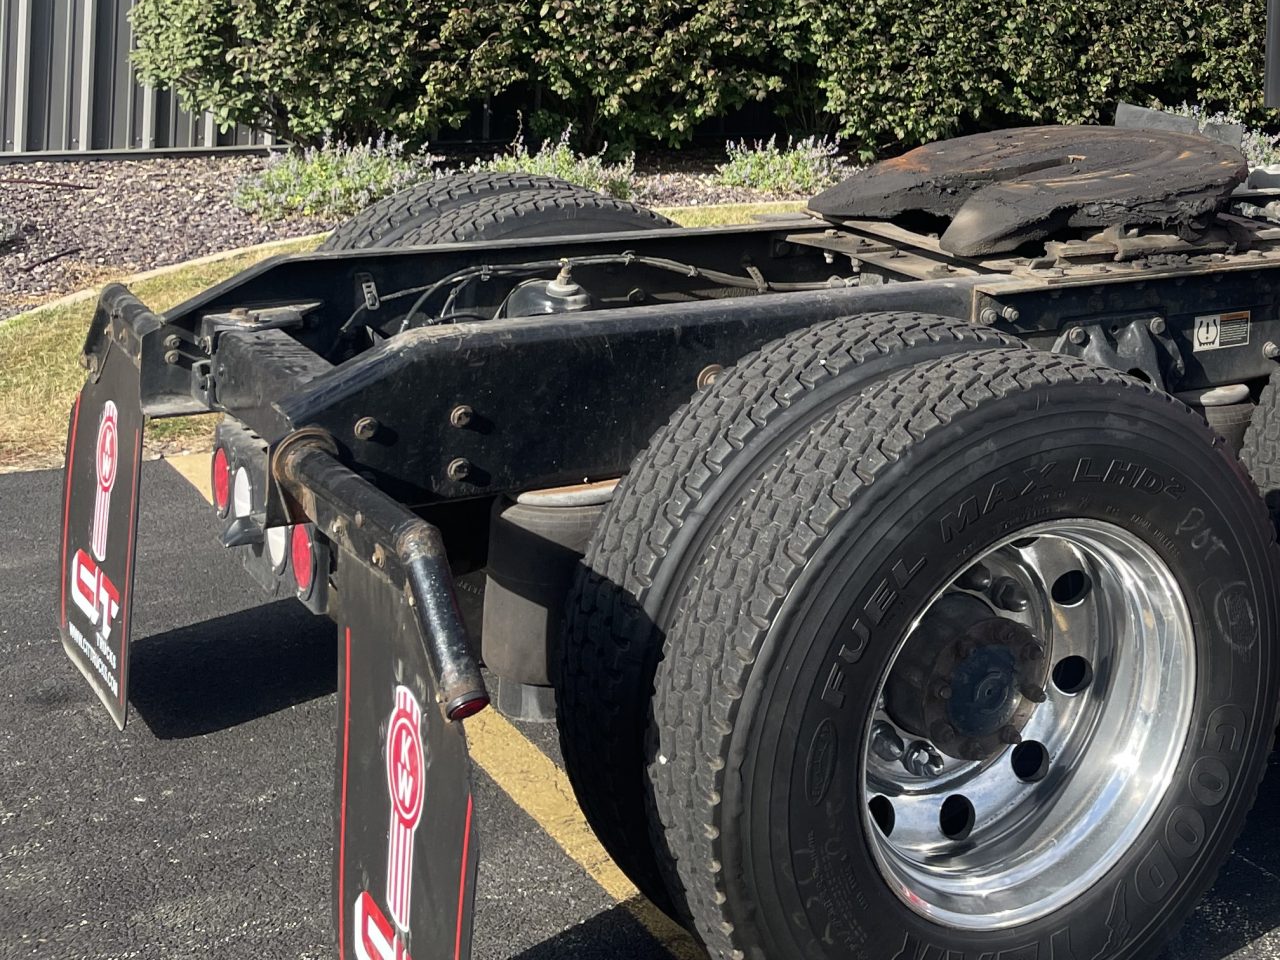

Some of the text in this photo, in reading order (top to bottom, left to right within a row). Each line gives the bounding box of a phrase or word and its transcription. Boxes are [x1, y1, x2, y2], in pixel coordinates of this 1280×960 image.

[71, 548, 120, 640] CIT
[820, 552, 927, 709] FUEL
[940, 462, 1058, 543] MAX
[96, 631, 117, 669] TRUCKS
